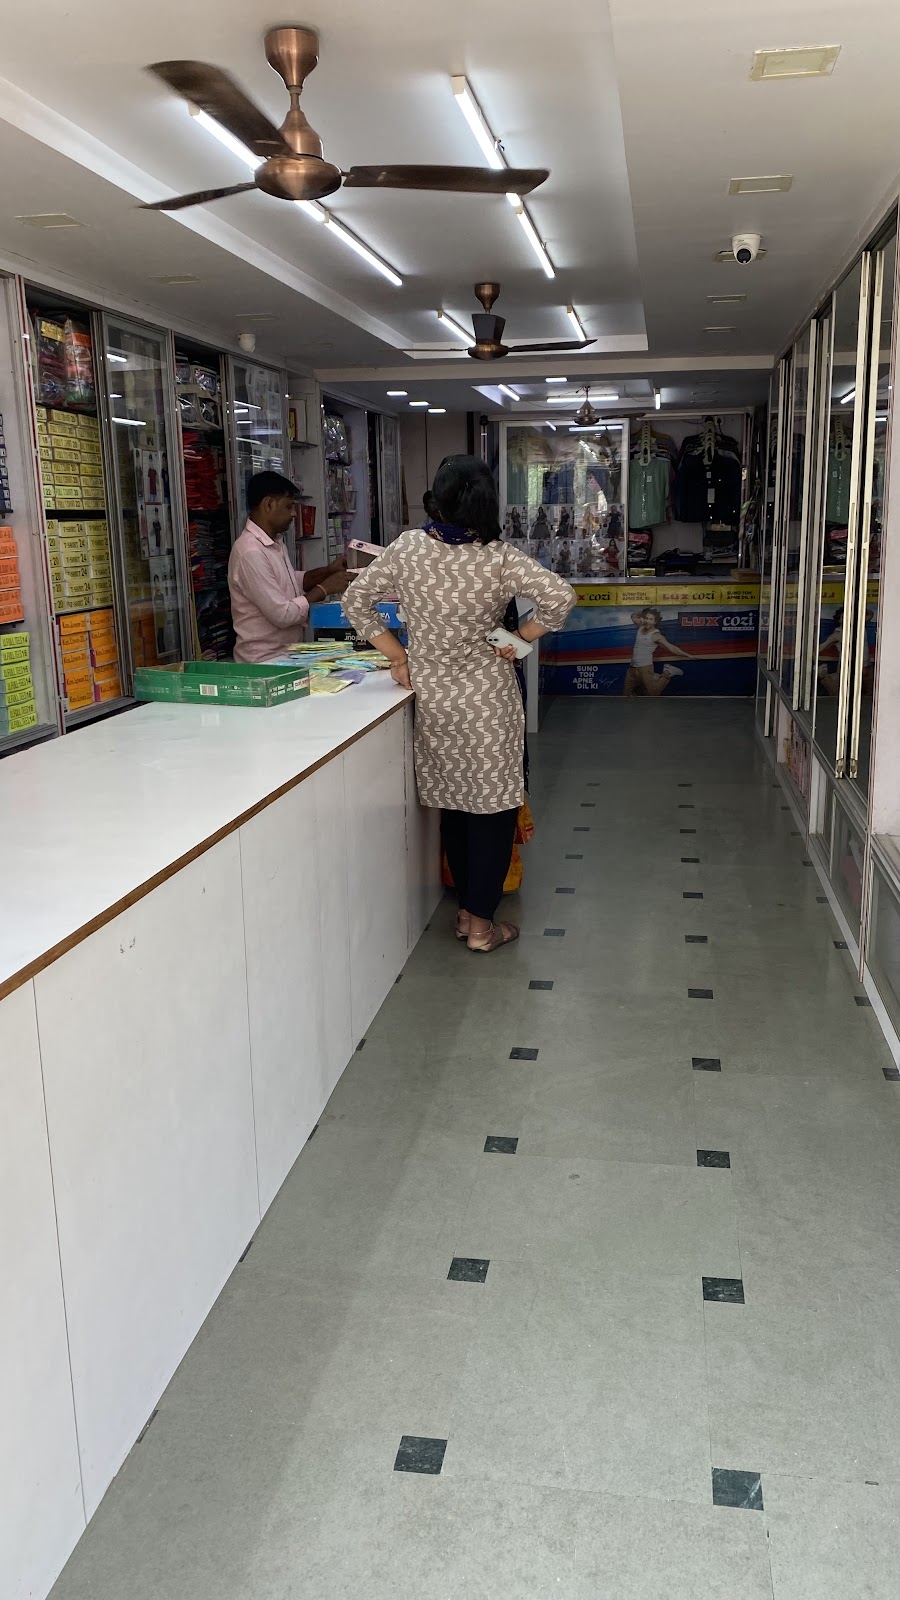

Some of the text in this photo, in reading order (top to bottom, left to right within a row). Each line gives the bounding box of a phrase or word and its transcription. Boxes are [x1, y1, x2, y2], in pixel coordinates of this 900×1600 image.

[77, 524, 82, 532] 24
[50, 538, 56, 546] 20
[79, 539, 85, 547] 24
[53, 557, 59, 565] 20
[80, 554, 86, 562] 24
[81, 568, 87, 576] 24
[56, 584, 61, 592] 20
[84, 583, 90, 591] 24
[589, 592, 611, 601] cozi
[692, 590, 715, 600] cozi
[682, 612, 754, 626] LUX cozi
